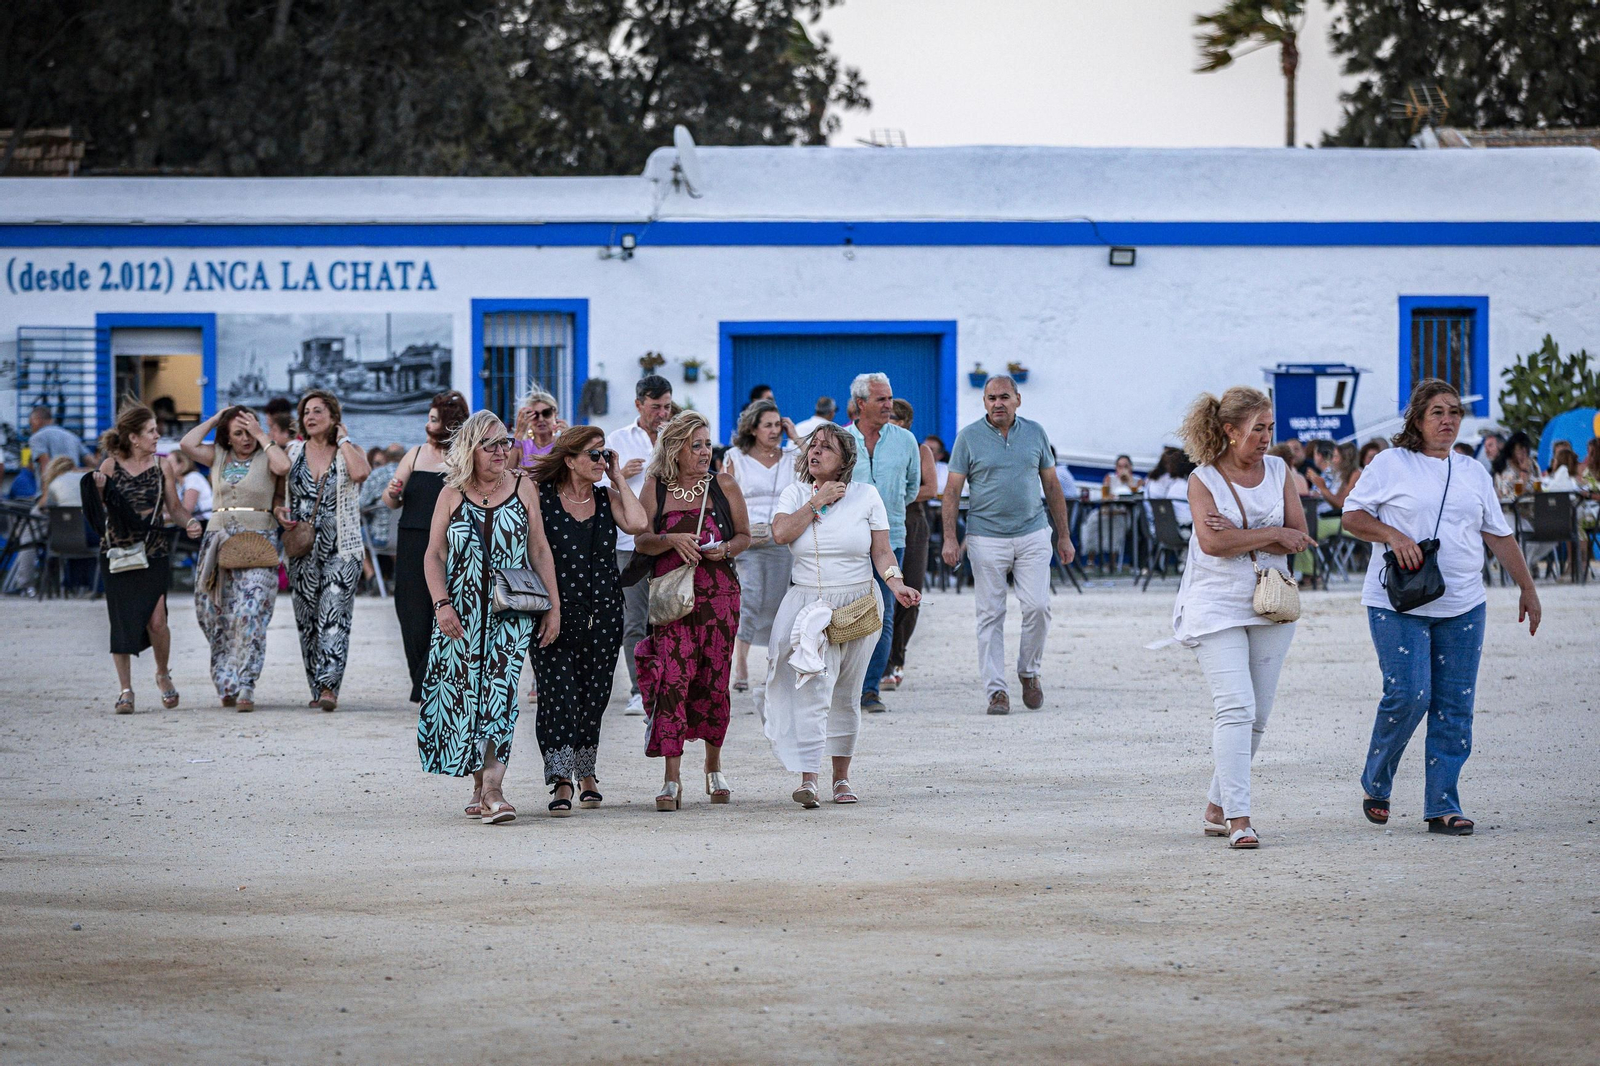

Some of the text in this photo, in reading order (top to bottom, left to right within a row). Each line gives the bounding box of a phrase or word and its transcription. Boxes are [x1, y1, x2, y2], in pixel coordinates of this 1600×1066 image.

[6, 256, 438, 295] (desde 2.012) ANCA LA CHATA
